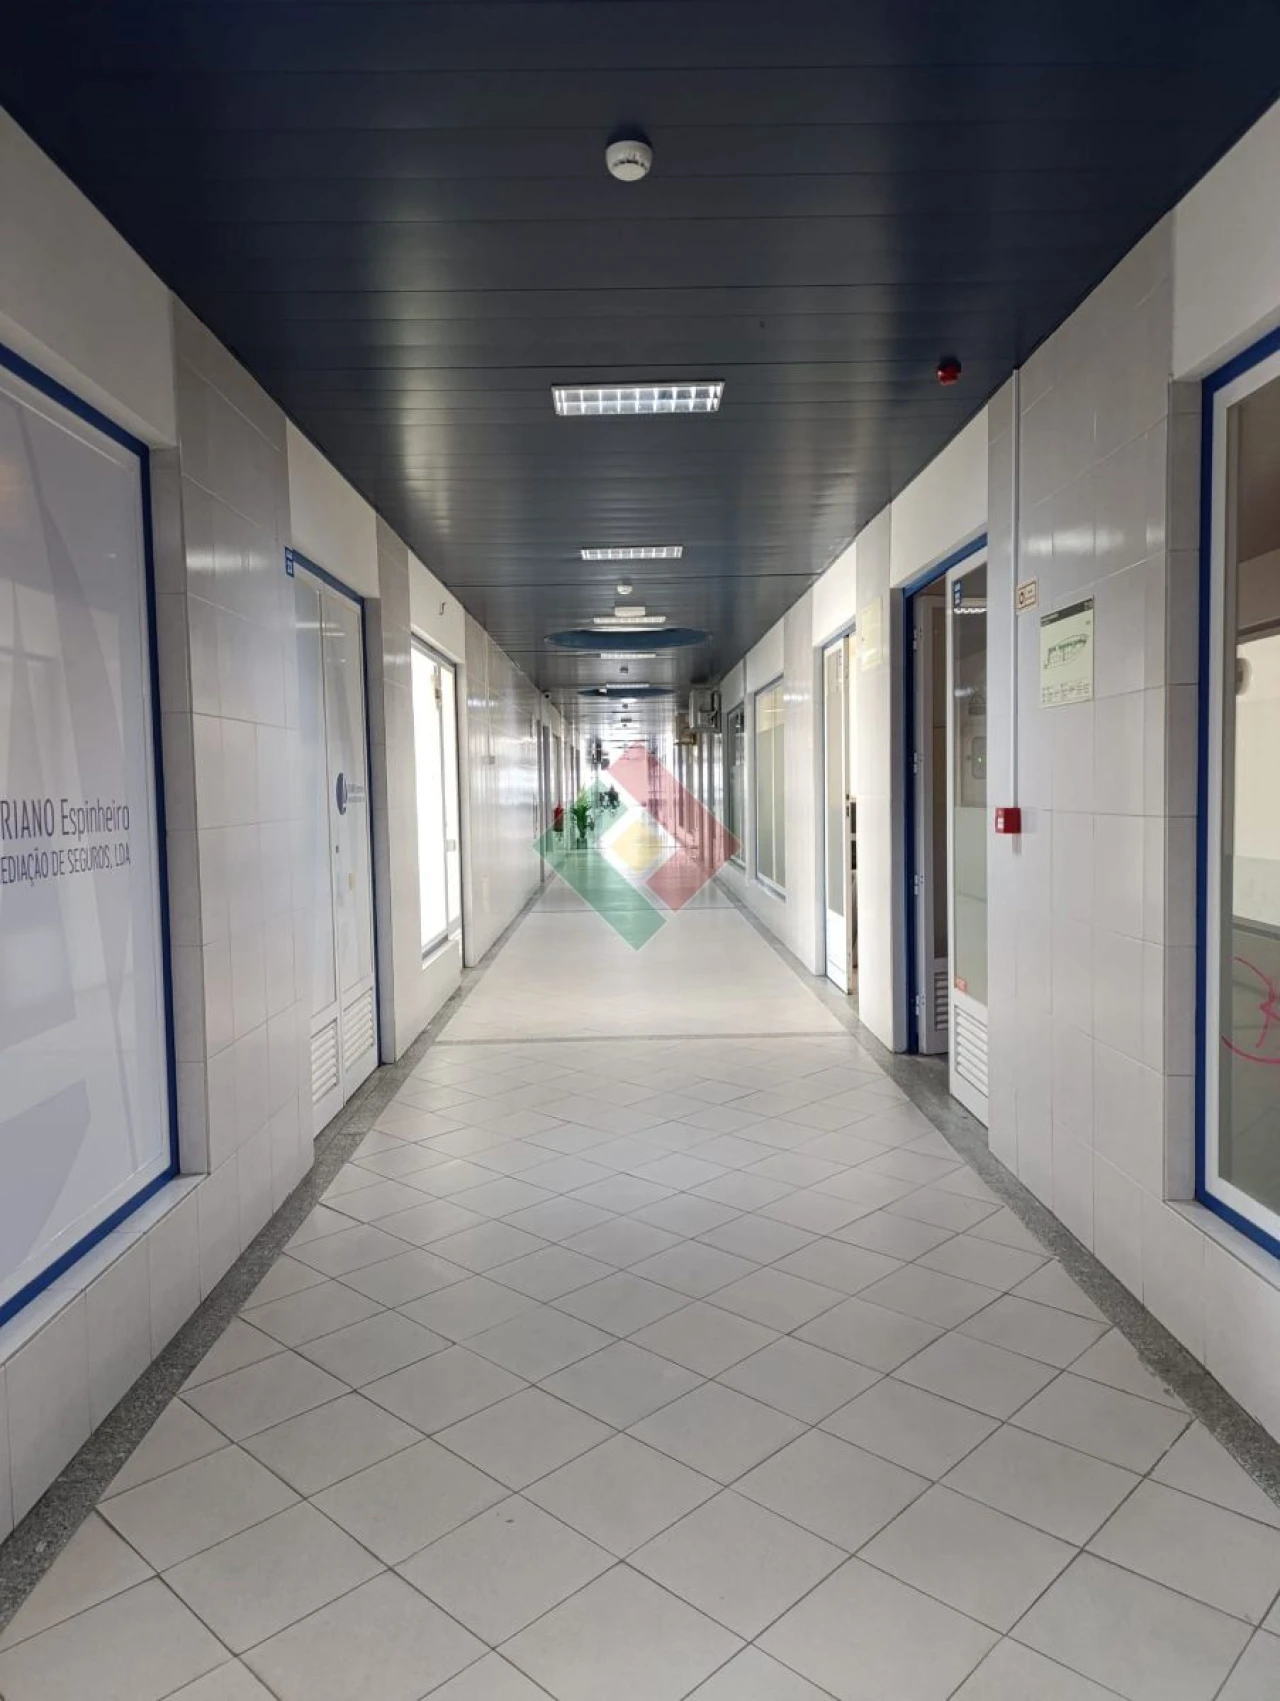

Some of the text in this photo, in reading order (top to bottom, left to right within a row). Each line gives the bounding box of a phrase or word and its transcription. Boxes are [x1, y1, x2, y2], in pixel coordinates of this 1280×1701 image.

[60, 798, 130, 842] Espinheiro
[51, 850, 65, 877] DE
[67, 844, 113, 874] SEGUROS,
[114, 842, 131, 868] LDA
